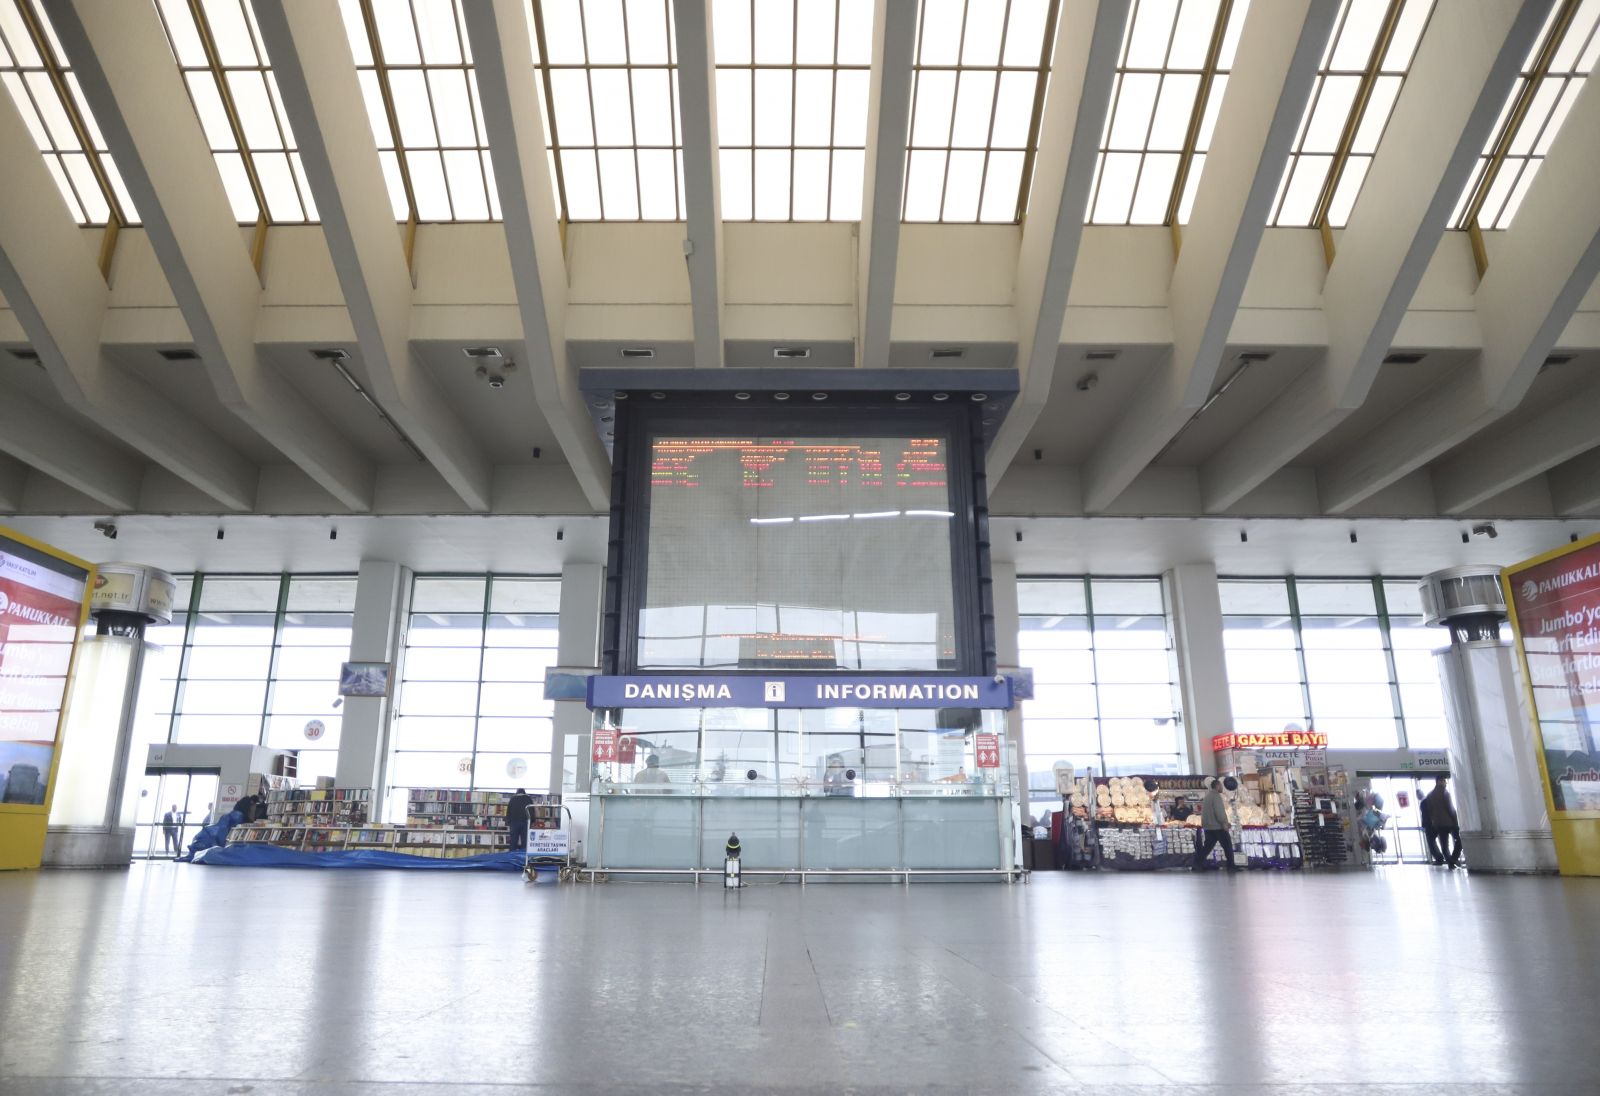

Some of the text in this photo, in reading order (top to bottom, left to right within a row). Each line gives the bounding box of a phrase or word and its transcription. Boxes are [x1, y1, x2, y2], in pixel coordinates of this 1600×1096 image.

[624, 683, 733, 701] DANIŞMA
[816, 684, 979, 699] INFORMATION
[308, 728, 320, 736] 30
[1238, 734, 1290, 746] GAZETE
[1265, 751, 1300, 759] GAZETE
